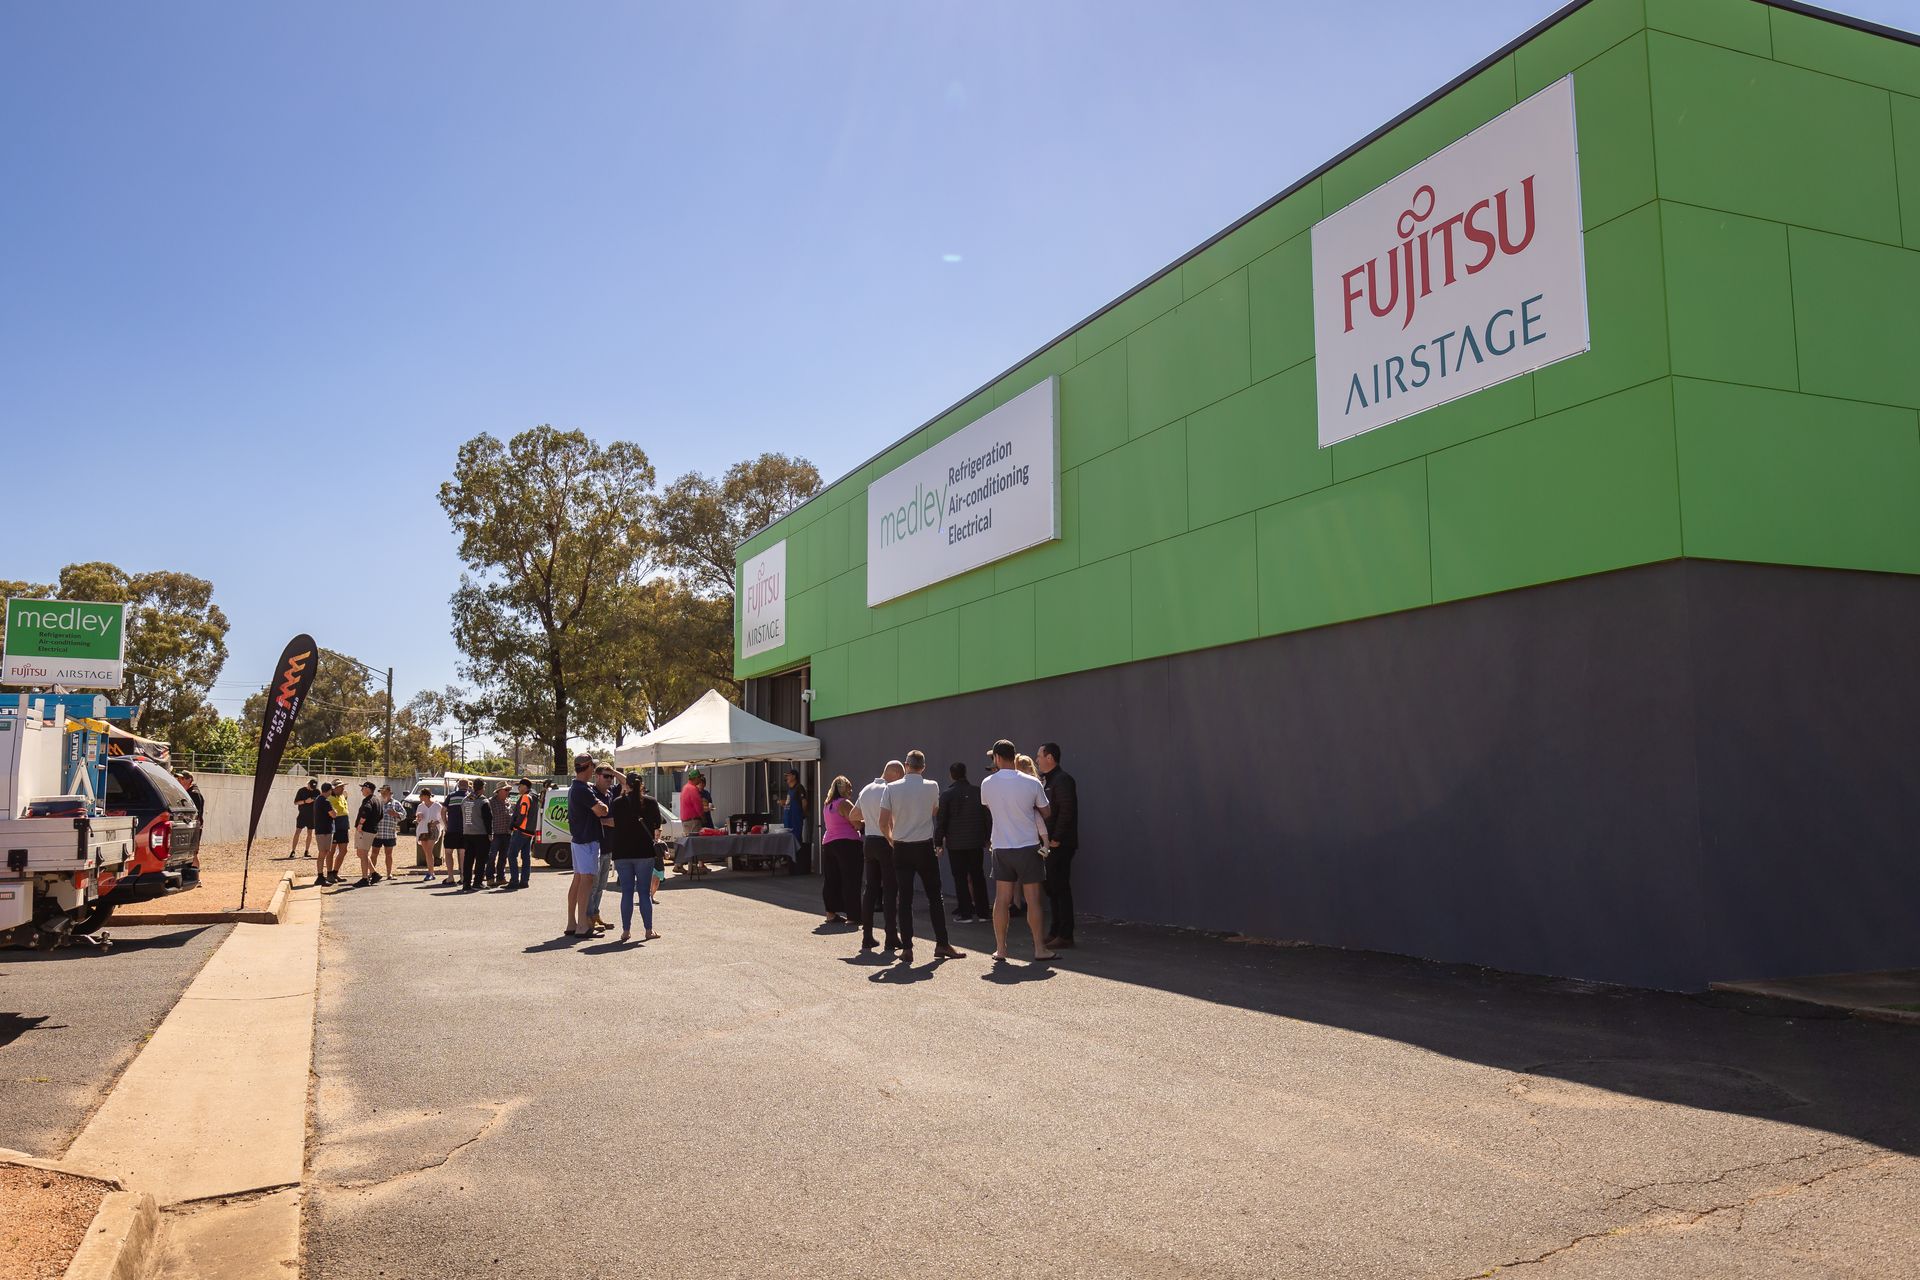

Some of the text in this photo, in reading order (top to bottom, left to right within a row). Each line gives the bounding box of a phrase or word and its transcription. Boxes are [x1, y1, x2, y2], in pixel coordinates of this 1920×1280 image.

[1341, 174, 1536, 333] FUJITSU
[1345, 293, 1547, 415] AIRSTAGE
[948, 440, 1013, 487] Refrigeration
[948, 464, 1030, 517] Air-conditioning
[880, 482, 948, 550] medley
[948, 508, 992, 545] Electrical
[747, 570, 780, 618] FUJITSU
[17, 607, 113, 637] medley
[39, 631, 82, 639] Refrigeration
[746, 618, 780, 649] AIRSTAGE
[38, 639, 91, 648] Air-conditioning
[11, 666, 113, 680] FUJITSU AIRSTAGE
[264, 699, 285, 751] TRIPLE
[276, 711, 287, 735] 93.5
[71, 733, 79, 761] BAILEY
